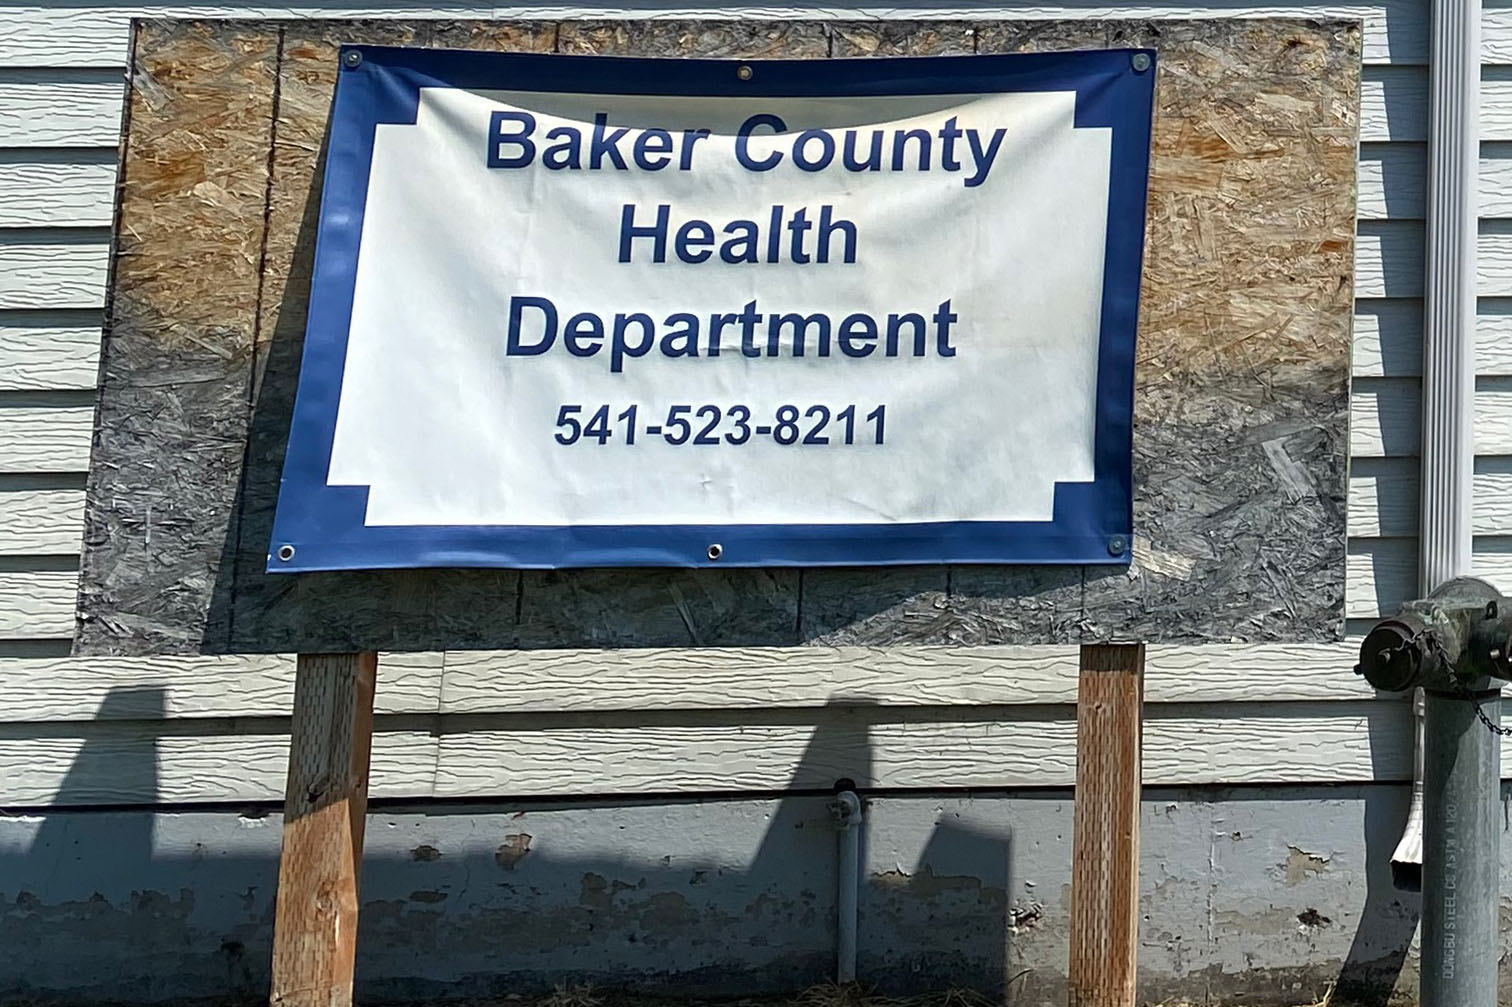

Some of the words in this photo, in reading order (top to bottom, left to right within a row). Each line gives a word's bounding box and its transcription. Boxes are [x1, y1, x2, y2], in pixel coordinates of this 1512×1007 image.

[486, 109, 712, 173] Baker
[735, 113, 1006, 188] County
[618, 203, 860, 266] Health
[505, 293, 959, 372] Department
[553, 403, 888, 447] 541-523-8211
[1443, 891, 1457, 931] STEEL
